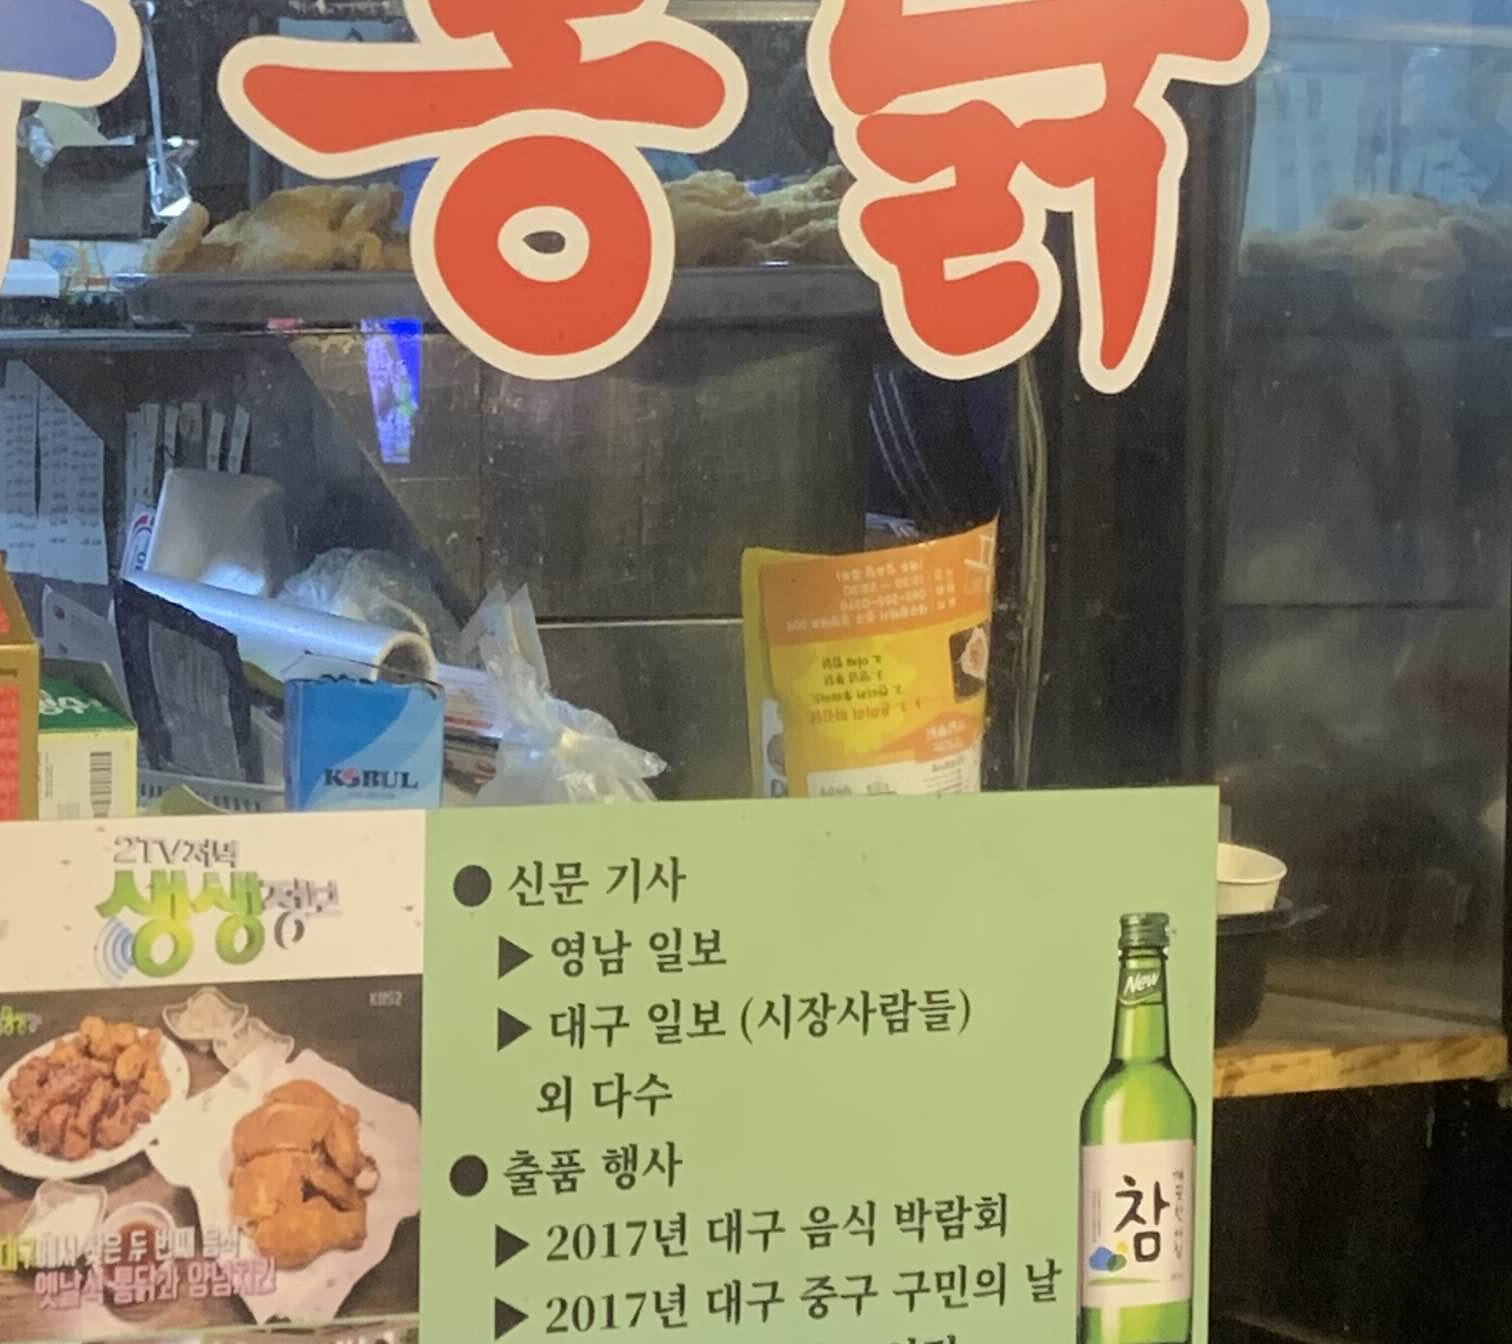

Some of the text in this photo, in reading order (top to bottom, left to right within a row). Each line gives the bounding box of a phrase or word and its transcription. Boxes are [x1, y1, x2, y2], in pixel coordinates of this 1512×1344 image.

[508, 855, 687, 907] 신문 기사
[551, 927, 727, 978] 영남 일보
[1122, 971, 1160, 997] New
[549, 988, 971, 1050] 대구 일보 (시장사람들)
[536, 1072, 673, 1123] 외 다수
[503, 1140, 684, 1197] 출품 행사
[546, 1191, 1008, 1262] 2017년 대구 음식 박람회
[1114, 1174, 1170, 1263] 참
[545, 1258, 1063, 1334] 2017년 대구 중구 구민의 날
